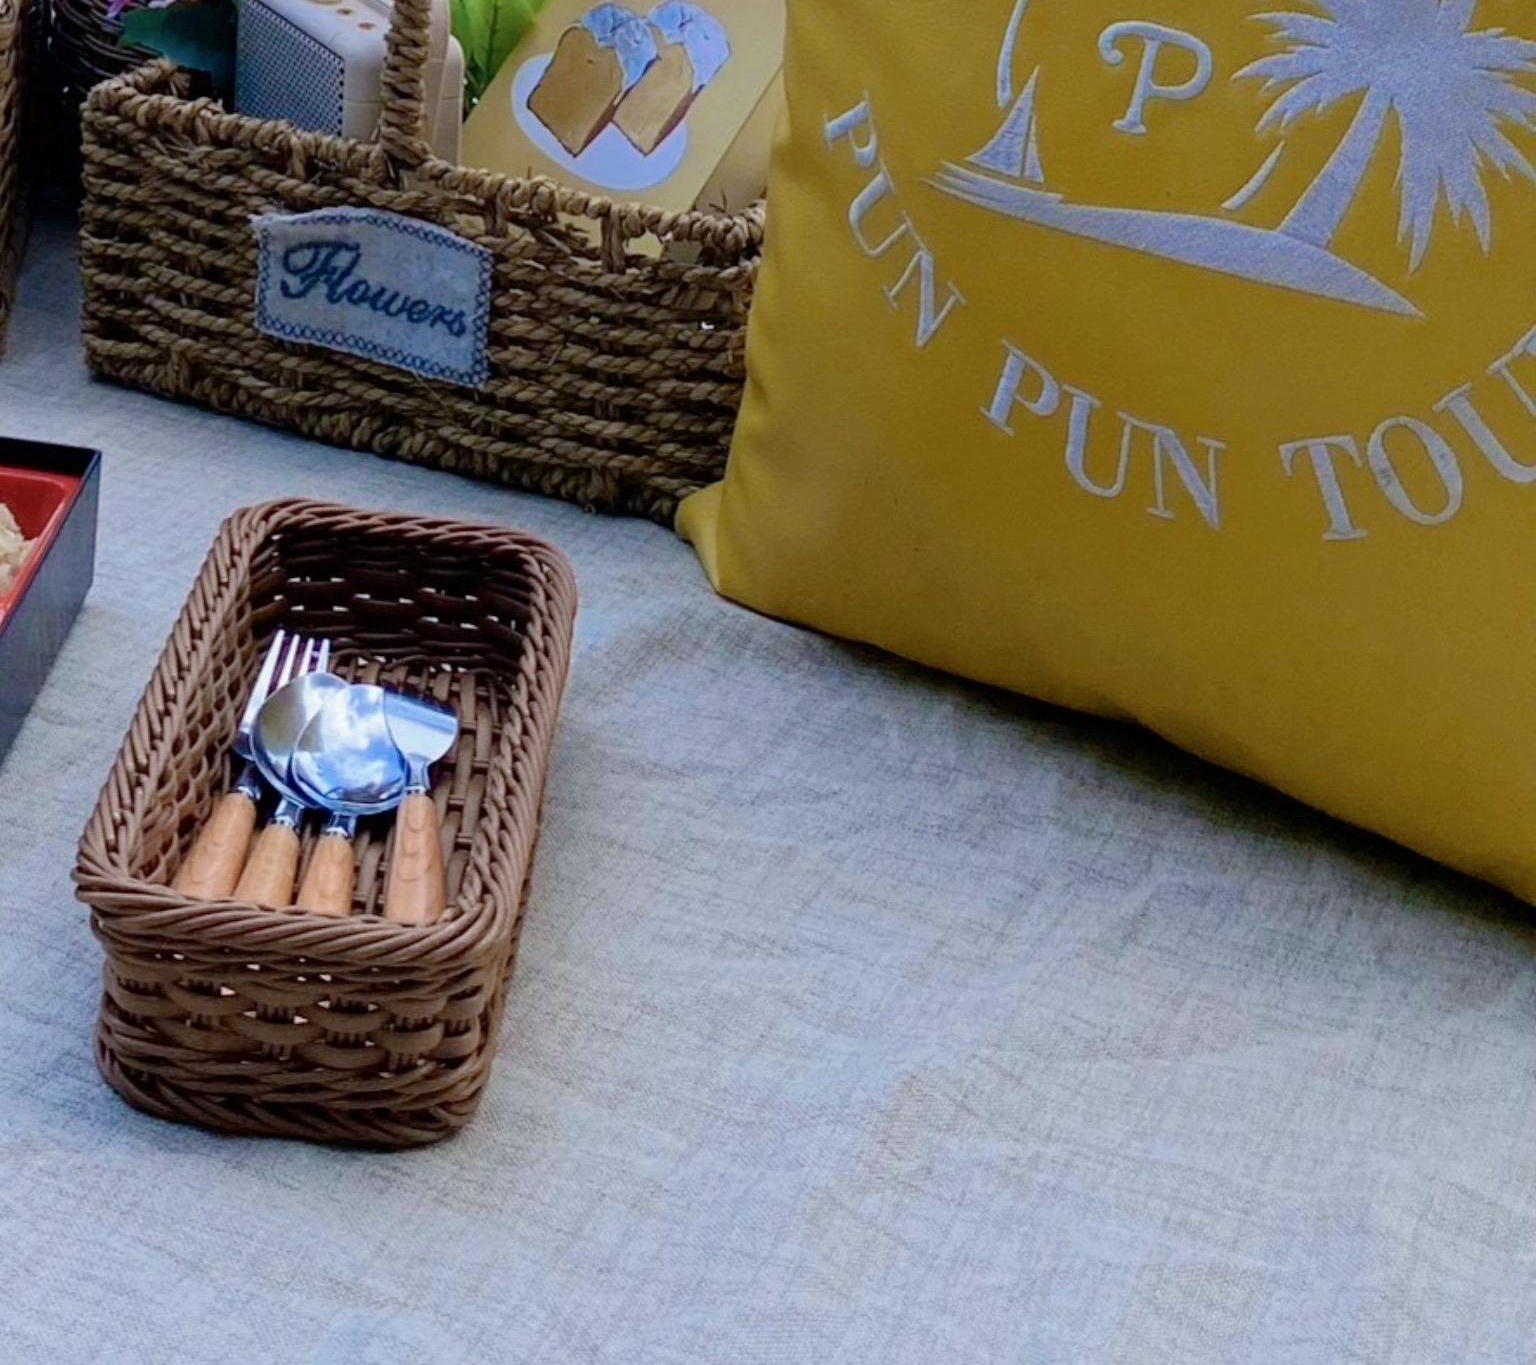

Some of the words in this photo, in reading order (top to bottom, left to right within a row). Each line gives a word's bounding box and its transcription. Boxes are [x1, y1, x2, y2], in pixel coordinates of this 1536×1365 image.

[1097, 20, 1213, 136] P
[279, 240, 467, 338] Flowers
[822, 90, 966, 349] PUN
[978, 338, 1228, 532] PUN
[1277, 322, 1536, 542] TOU
